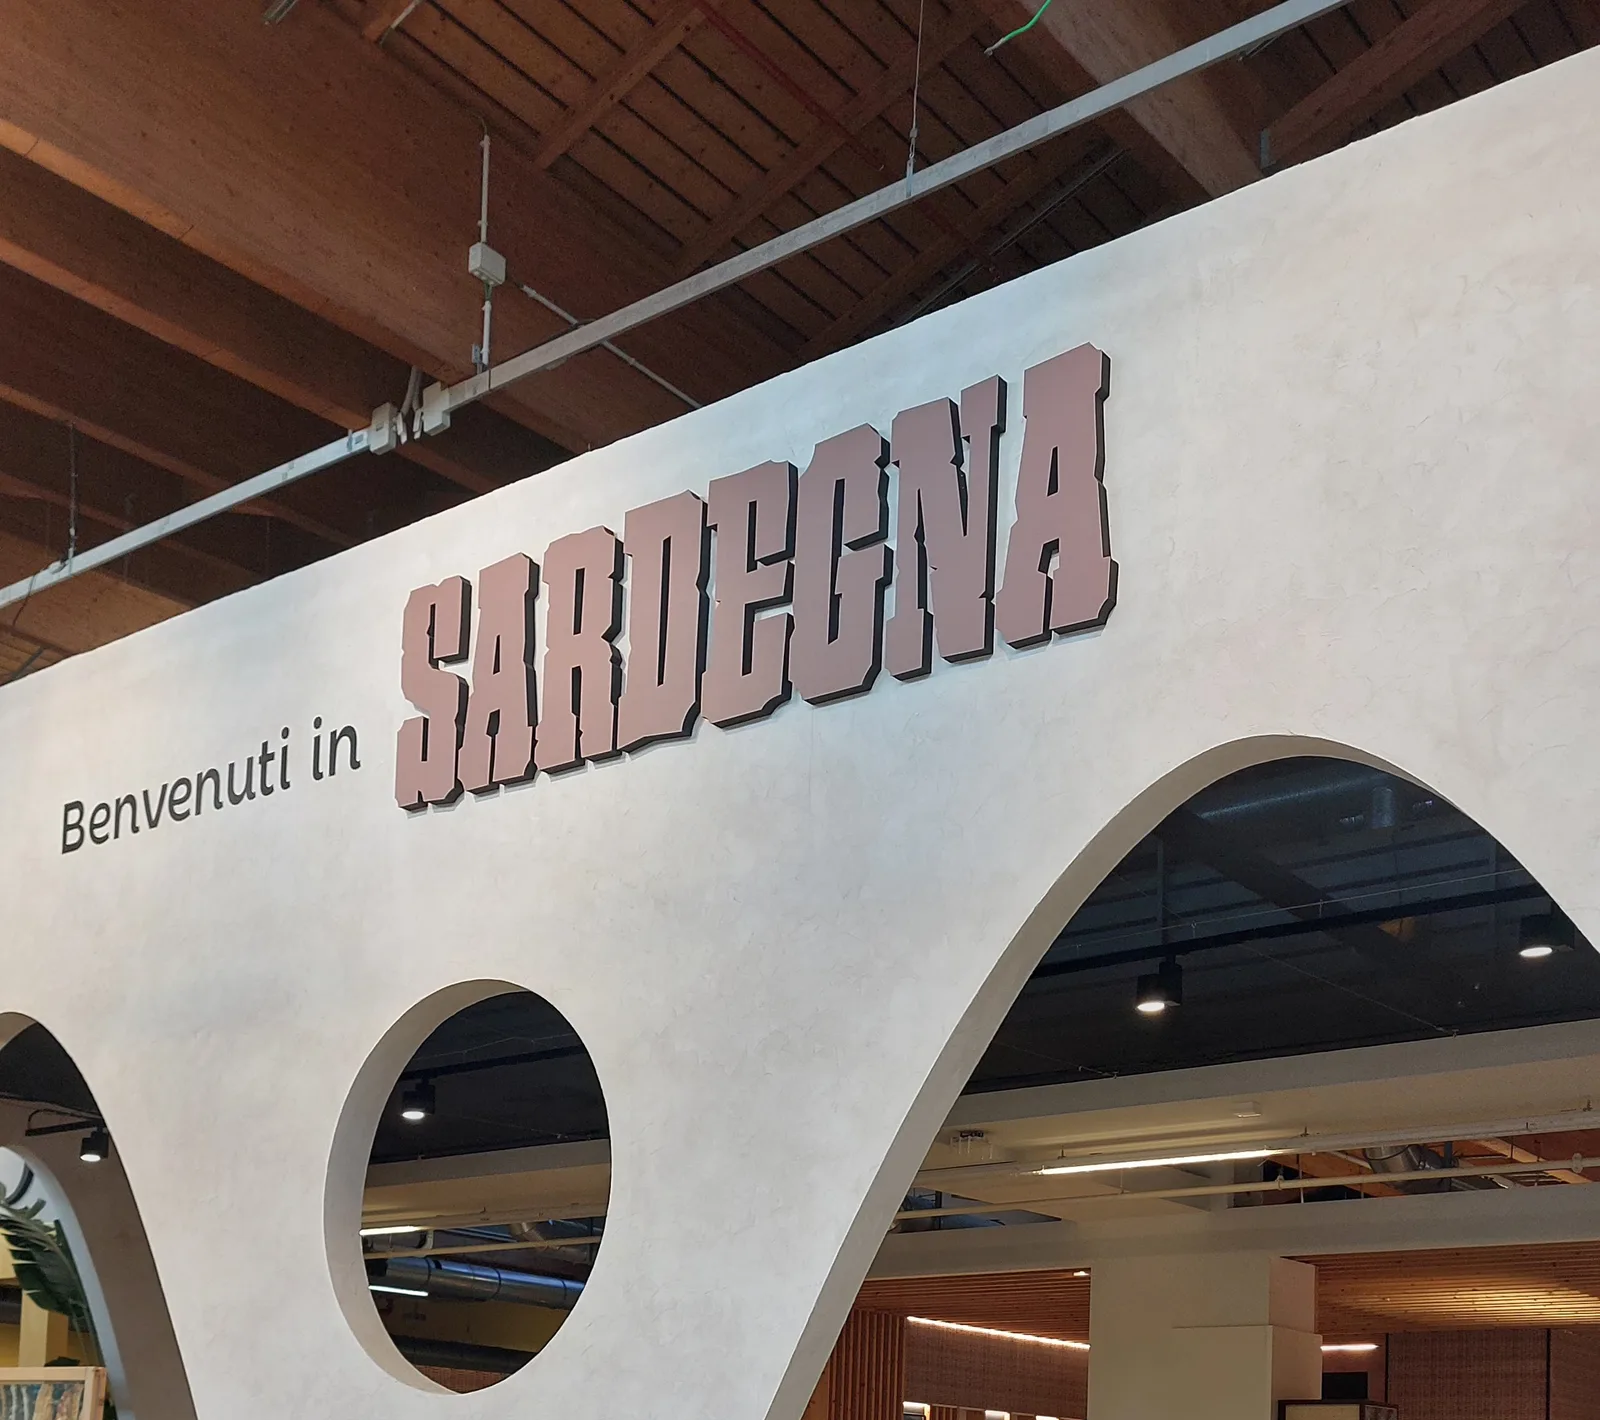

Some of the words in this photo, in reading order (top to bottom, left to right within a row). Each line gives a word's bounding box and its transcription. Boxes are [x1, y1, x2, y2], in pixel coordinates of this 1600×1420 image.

[61, 726, 291, 855] Benvenuti
[312, 716, 362, 781] in
[395, 340, 1121, 812] SARDEGNA
